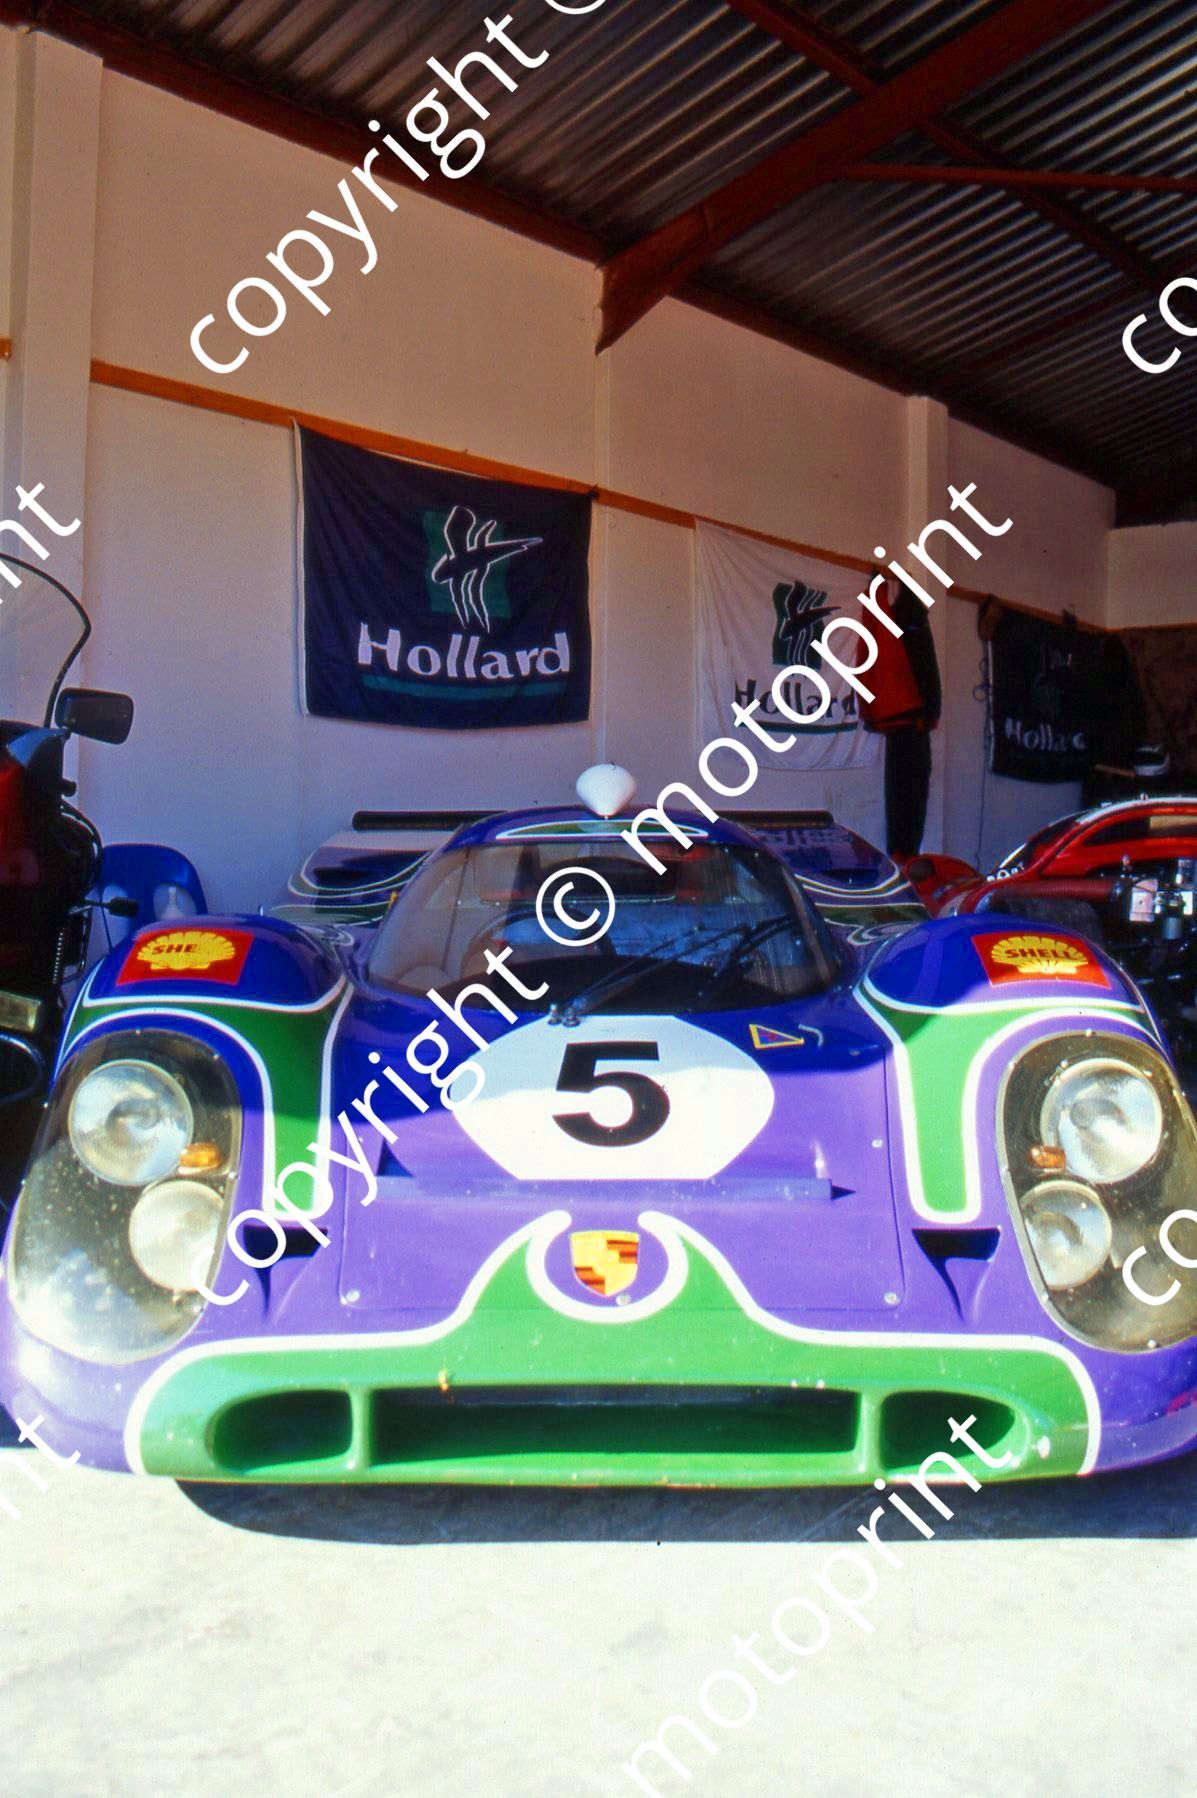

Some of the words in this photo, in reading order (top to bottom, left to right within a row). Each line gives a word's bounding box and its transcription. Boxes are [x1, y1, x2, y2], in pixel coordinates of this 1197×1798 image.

[357, 622, 570, 680] Hollard
[1005, 717, 1086, 752] Holla
[1004, 948, 1080, 960] SHELL
[552, 1040, 671, 1148] 5
